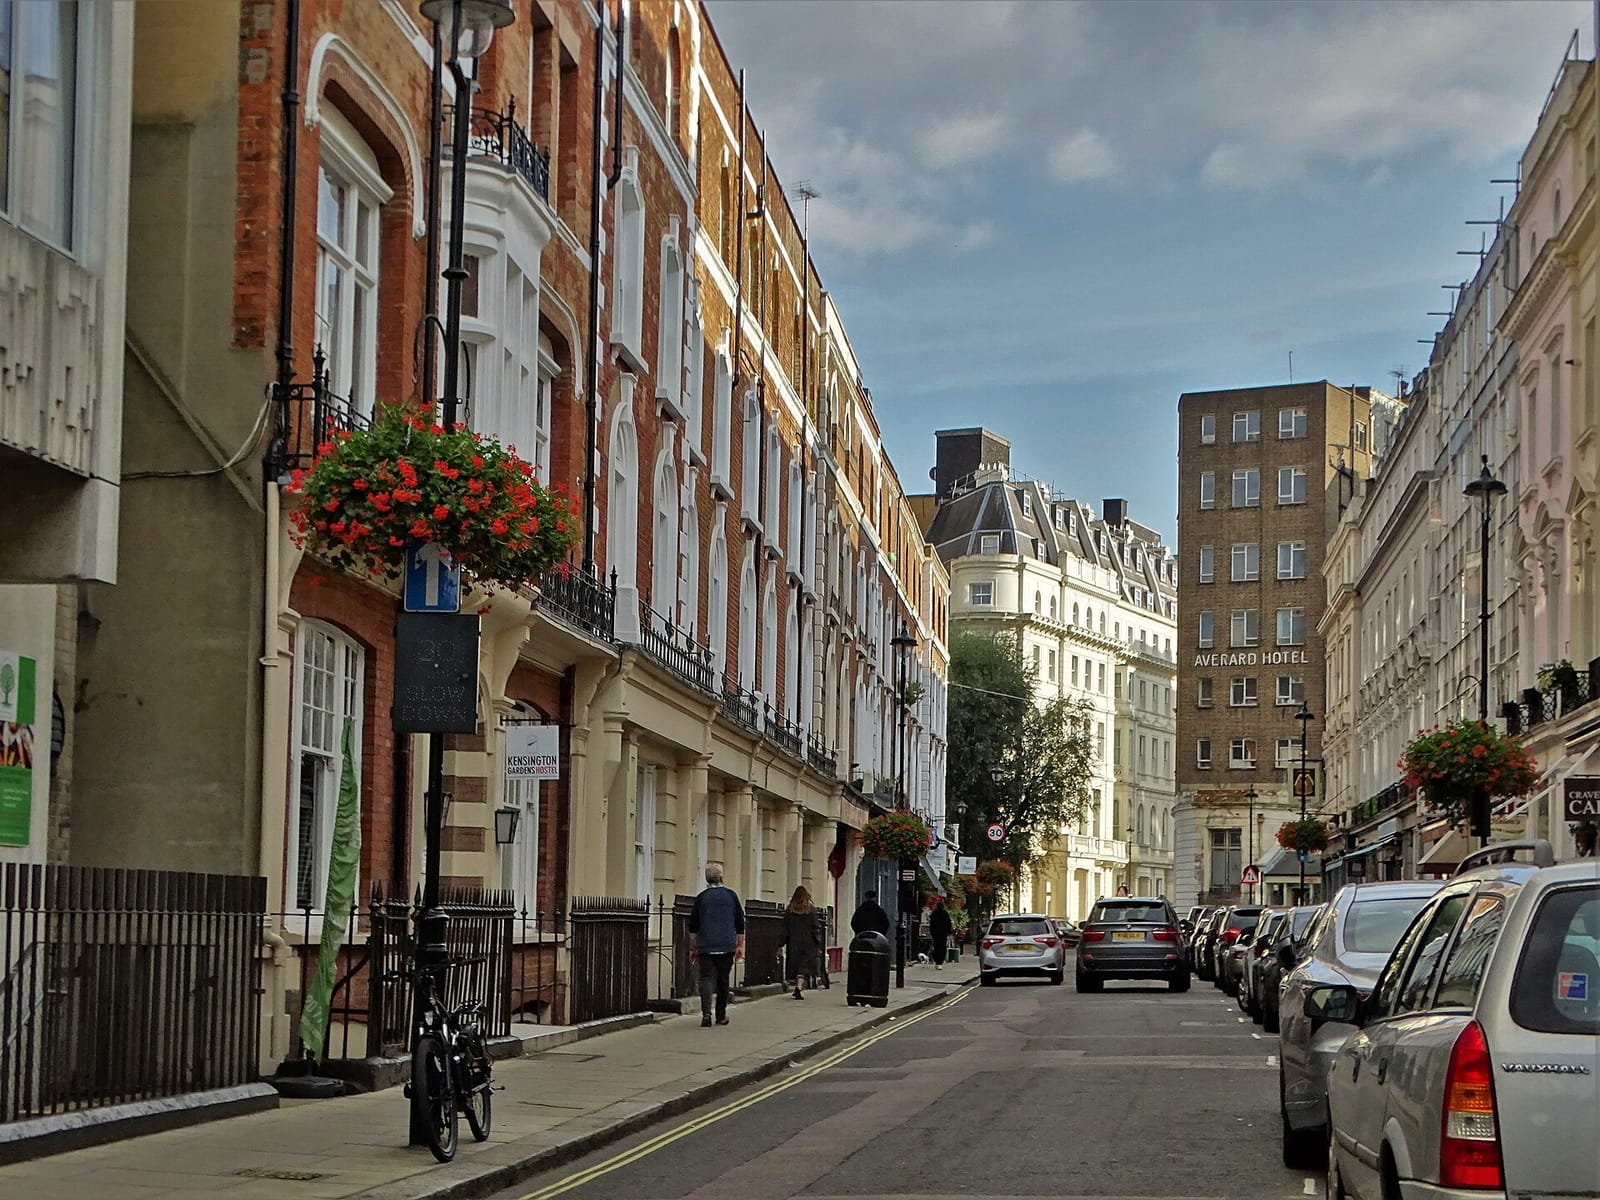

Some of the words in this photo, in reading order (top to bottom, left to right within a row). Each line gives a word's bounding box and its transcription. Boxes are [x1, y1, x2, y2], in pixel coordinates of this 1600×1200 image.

[1194, 653, 1257, 667] AVERARD
[1262, 651, 1309, 665] HOTEL
[407, 687, 465, 702] SLOW
[403, 705, 466, 721] DOWN
[507, 755, 557, 766] KENSINGTON
[989, 828, 1002, 837] 30
[1501, 1063, 1590, 1075] VAUXHALL
